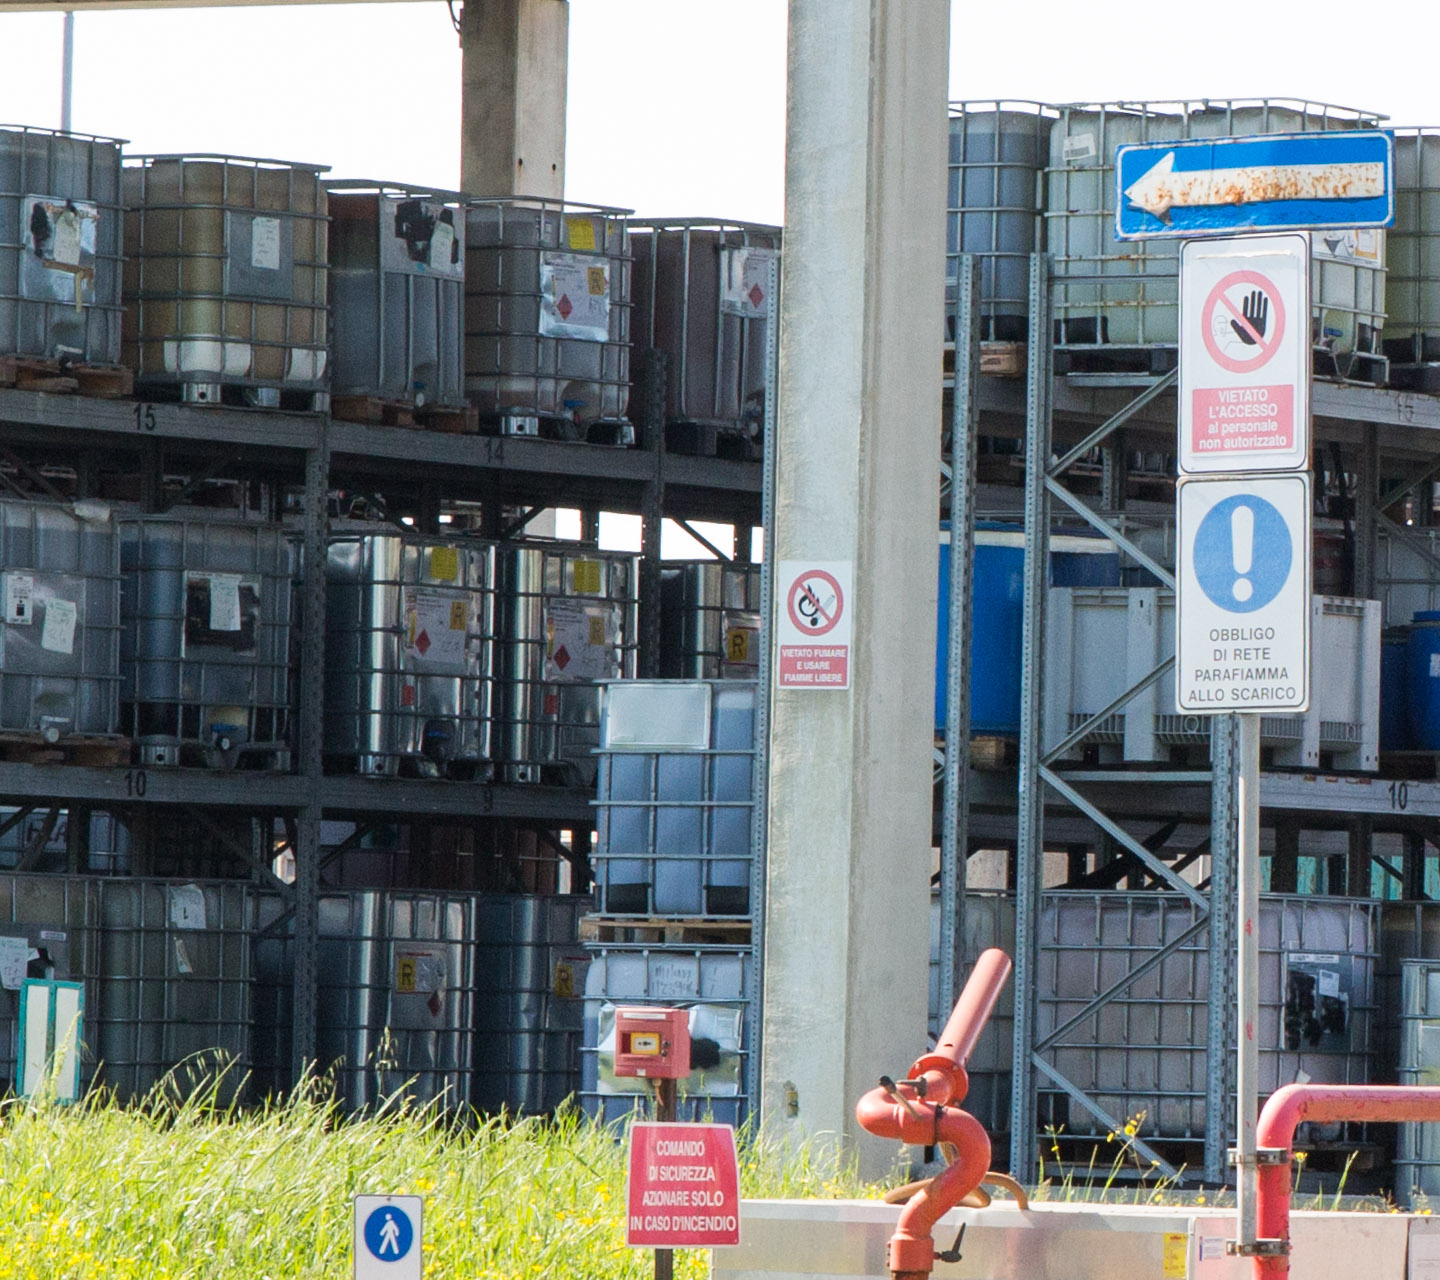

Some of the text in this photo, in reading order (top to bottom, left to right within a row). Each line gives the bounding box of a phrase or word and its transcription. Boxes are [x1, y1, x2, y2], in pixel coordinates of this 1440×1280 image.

[1218, 389, 1268, 403] VIETATO
[133, 403, 157, 431] 15
[1208, 403, 1279, 419] L'ACCESSO
[1208, 419, 1279, 436] al personale
[1199, 435, 1287, 449] non autorizzato
[1209, 627, 1275, 642] OBBLIGO
[733, 634, 744, 657] R
[781, 648, 847, 658] VIETATO FUMARE
[1214, 647, 1271, 661] DI RETE
[796, 661, 831, 670] E USARE
[784, 673, 843, 683] FIAMME LIBERE
[1195, 667, 1289, 681] PARAFIAMMA
[1188, 686, 1296, 702] ALLO SCARICO
[124, 770, 147, 798] 10
[1389, 781, 1408, 810] 10
[656, 1141, 705, 1156] COMANDO
[648, 1166, 715, 1182] DI SICUREZZA
[642, 1191, 724, 1206] AZIONARE SOLO
[630, 1216, 736, 1232] IN CASO D'INCENDIO
